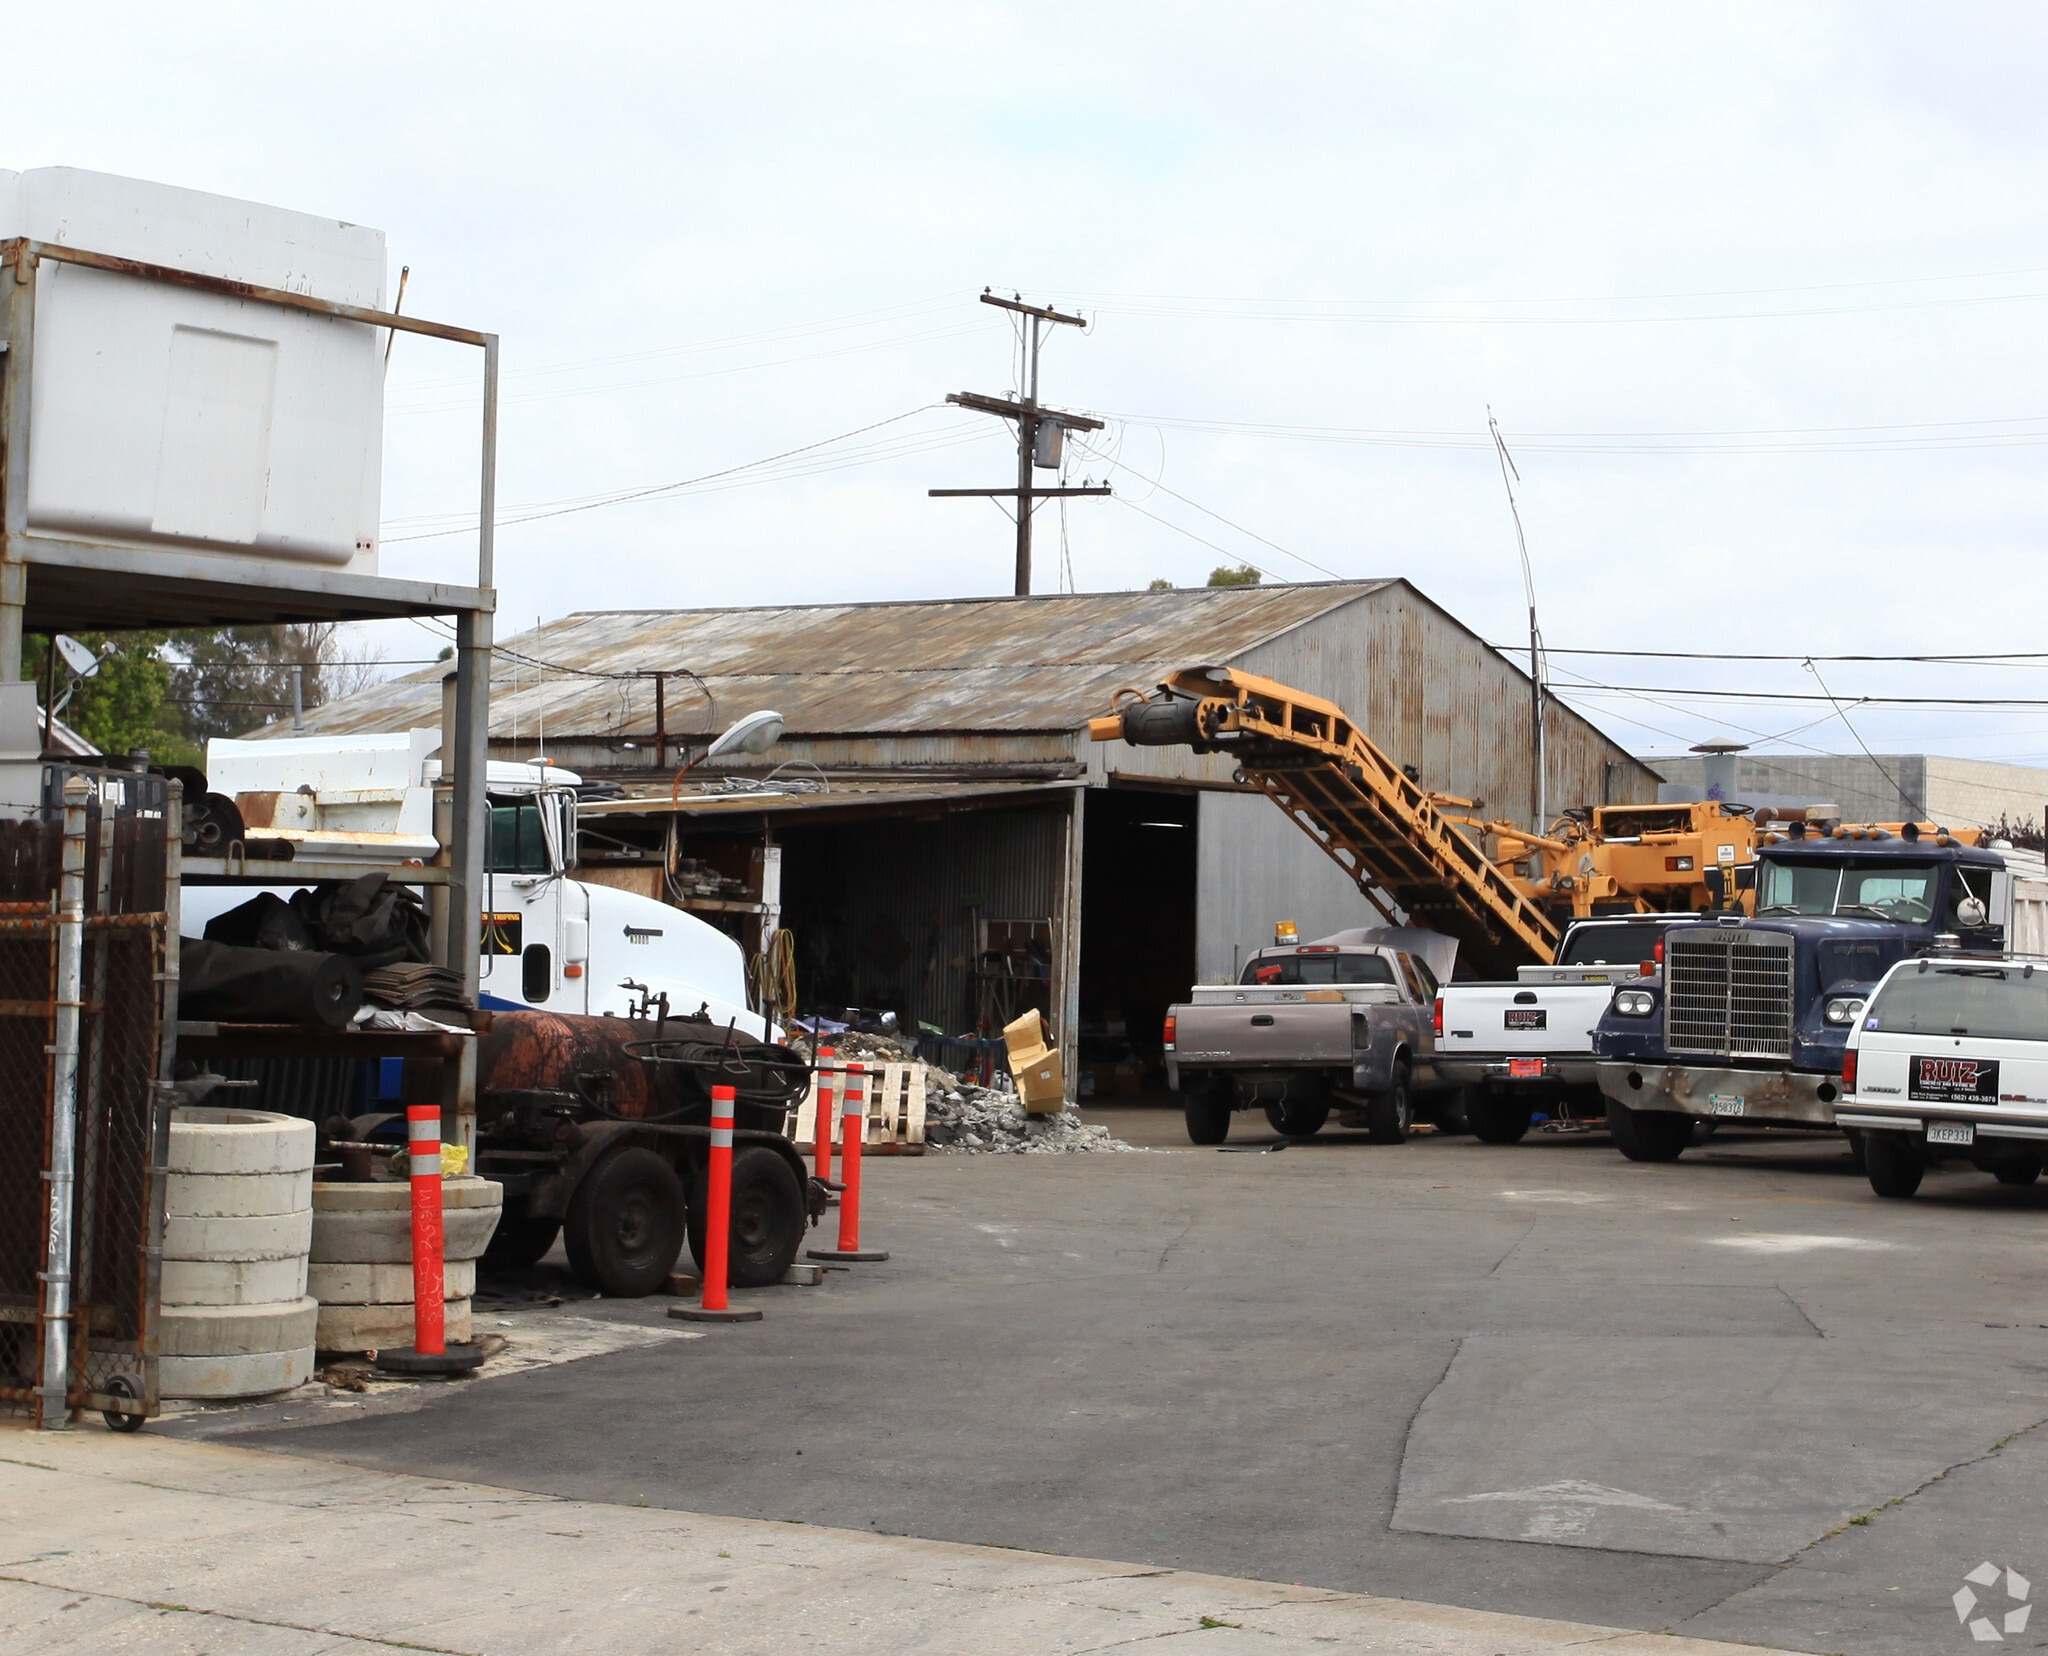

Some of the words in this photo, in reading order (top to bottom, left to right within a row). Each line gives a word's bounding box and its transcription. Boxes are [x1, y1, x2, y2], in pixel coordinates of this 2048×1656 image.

[1508, 1012, 1536, 1022] RUIZ
[1919, 1059, 1978, 1085] RUIZ
[1930, 1127, 1970, 1142] 3KEP331
